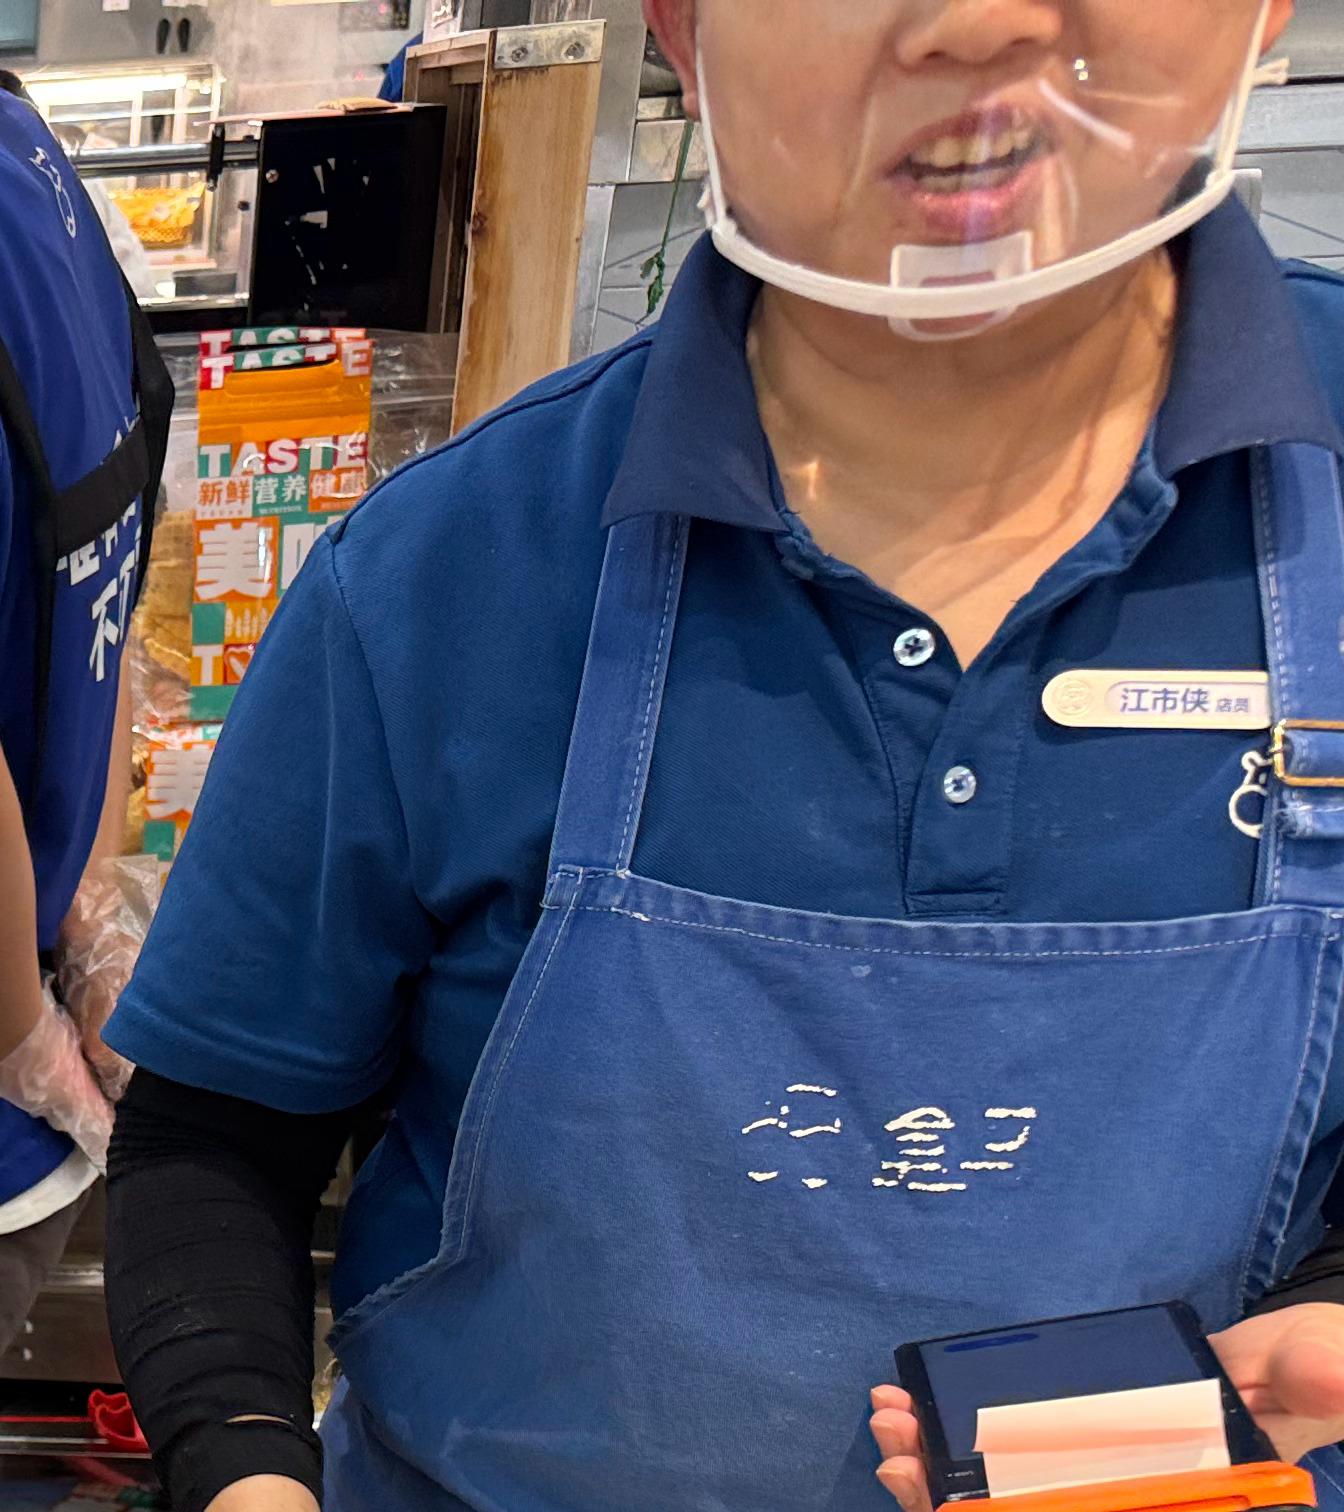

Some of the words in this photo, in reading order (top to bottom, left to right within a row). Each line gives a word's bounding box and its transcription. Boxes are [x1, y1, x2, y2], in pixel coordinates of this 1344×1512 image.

[198, 433, 367, 477] TASTE
[199, 480, 250, 507] 新鲜
[255, 474, 307, 505] 营养
[1120, 687, 1209, 714] 江市侠
[1215, 697, 1250, 714] 店员
